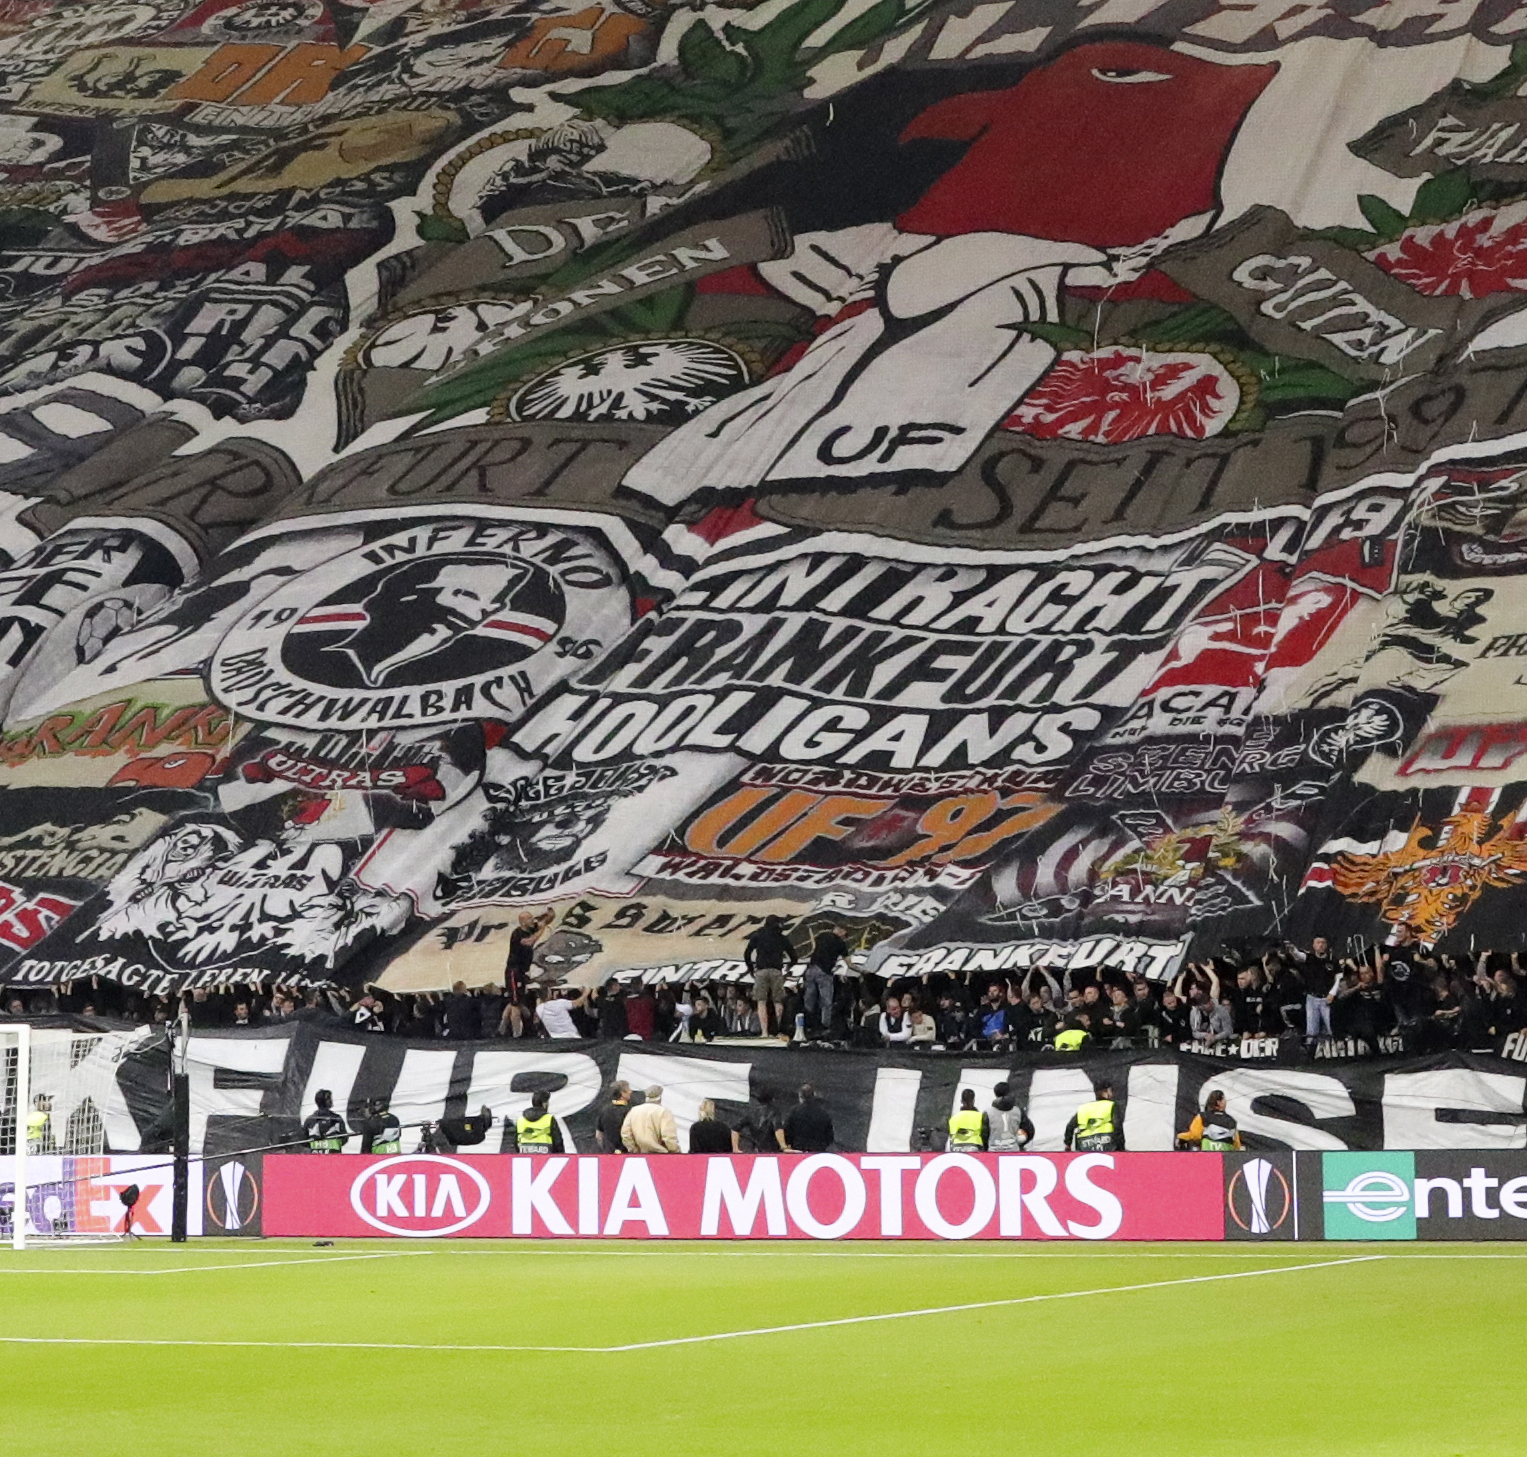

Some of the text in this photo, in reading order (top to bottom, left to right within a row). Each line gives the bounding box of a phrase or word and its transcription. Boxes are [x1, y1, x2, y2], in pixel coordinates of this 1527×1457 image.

[815, 423, 967, 466] UF
[672, 552, 1215, 634] EINTRACHT
[590, 615, 1137, 708] FRANKFURT
[513, 689, 1105, 770] HOOLIGANS
[266, 752, 409, 790] ULTRAS
[685, 787, 891, 863] UF
[19, 954, 178, 993] TOTGESAGTE
[876, 932, 1186, 981] FRANKFURT
[375, 1151, 1125, 1240] KIA KIA MOTORS
